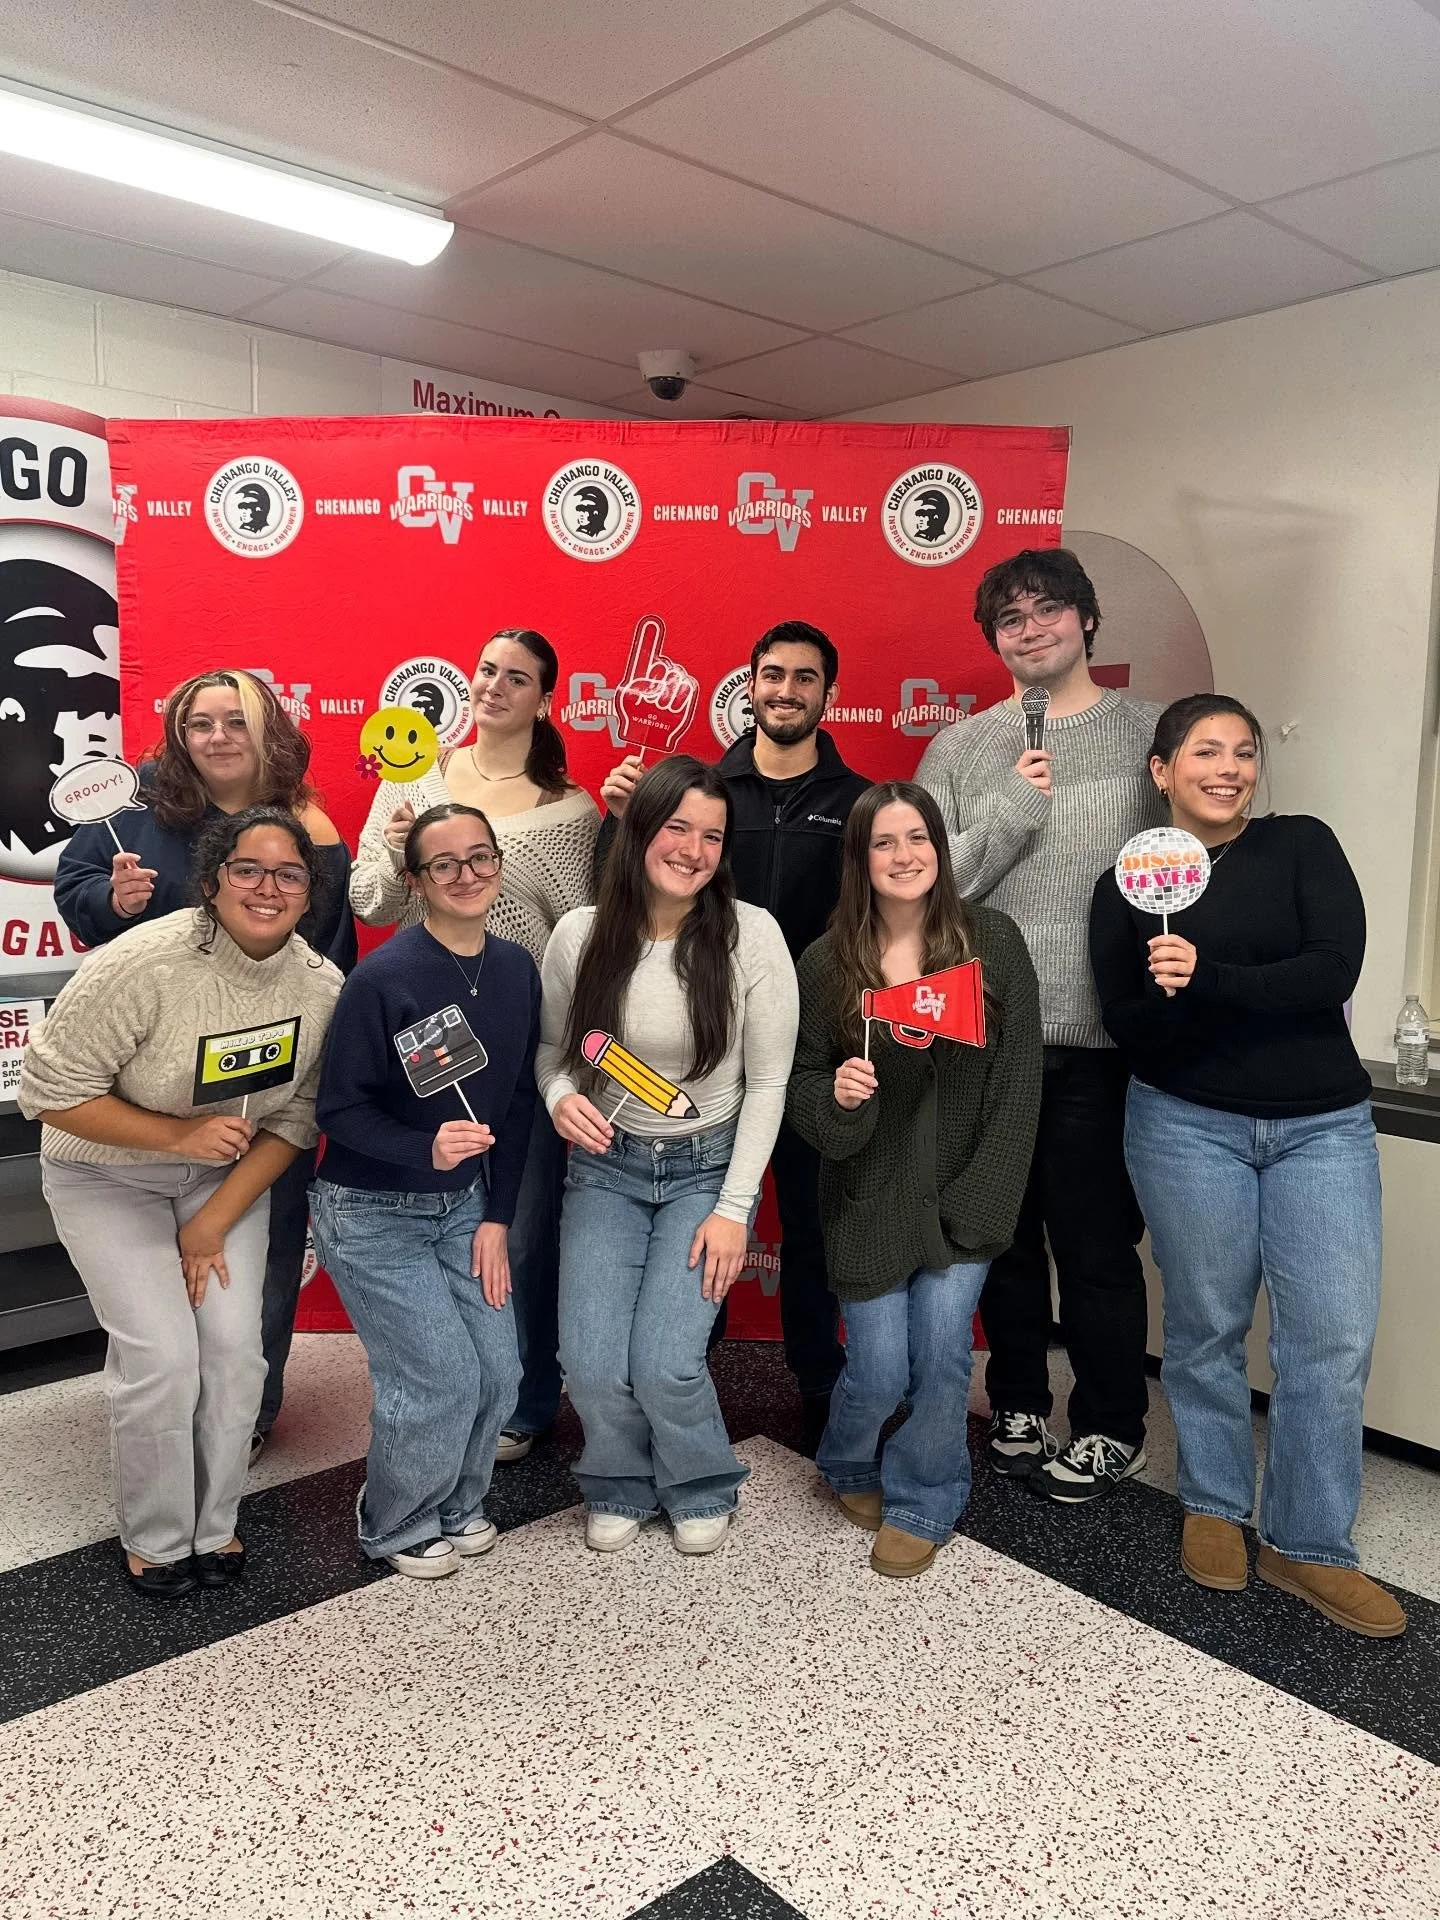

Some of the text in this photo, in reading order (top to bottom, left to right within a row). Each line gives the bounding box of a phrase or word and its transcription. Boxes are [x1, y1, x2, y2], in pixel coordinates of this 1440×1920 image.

[0, 437, 88, 508] GO
[210, 463, 297, 504] CHENANGO VALLEY
[548, 465, 636, 508] CHENANGO VALLEY
[397, 465, 475, 544] CV
[887, 469, 978, 512] CHENANGO VALLEY
[147, 501, 192, 517] VALLEY
[315, 499, 381, 515] CHENANGO
[389, 492, 473, 521] WARRIORS
[482, 499, 528, 517] VALLEY
[653, 504, 719, 521] CHENANGO
[728, 500, 812, 529] WARRIORS
[737, 472, 814, 552] CV
[821, 505, 868, 522] VALLEY
[996, 509, 1064, 525] CHENANGO
[211, 506, 297, 552] INSPIRE ENGAGE EMPOWER
[550, 510, 635, 555] INSPIRE ENGAGE EMPOWER
[888, 515, 976, 560] INSPIRE ENGAGE EMPOWER
[385, 663, 471, 703] CHENANGO VALLEY
[715, 671, 751, 709] CHENAN
[320, 699, 365, 714] VALLEY
[560, 699, 618, 724] WARRI
[892, 704, 972, 729] WARRIOR
[446, 706, 470, 743] EMPOWER
[632, 716, 671, 731] WARRIORS!
[716, 713, 735, 745] INSPIRE
[64, 774, 124, 804] GROOVY!
[813, 814, 842, 826] Columbia
[1123, 849, 1201, 871] DISCO
[1124, 869, 1202, 890] FEVER
[2, 1069, 21, 1078] sna
[12, 1059, 25, 1069] pr
